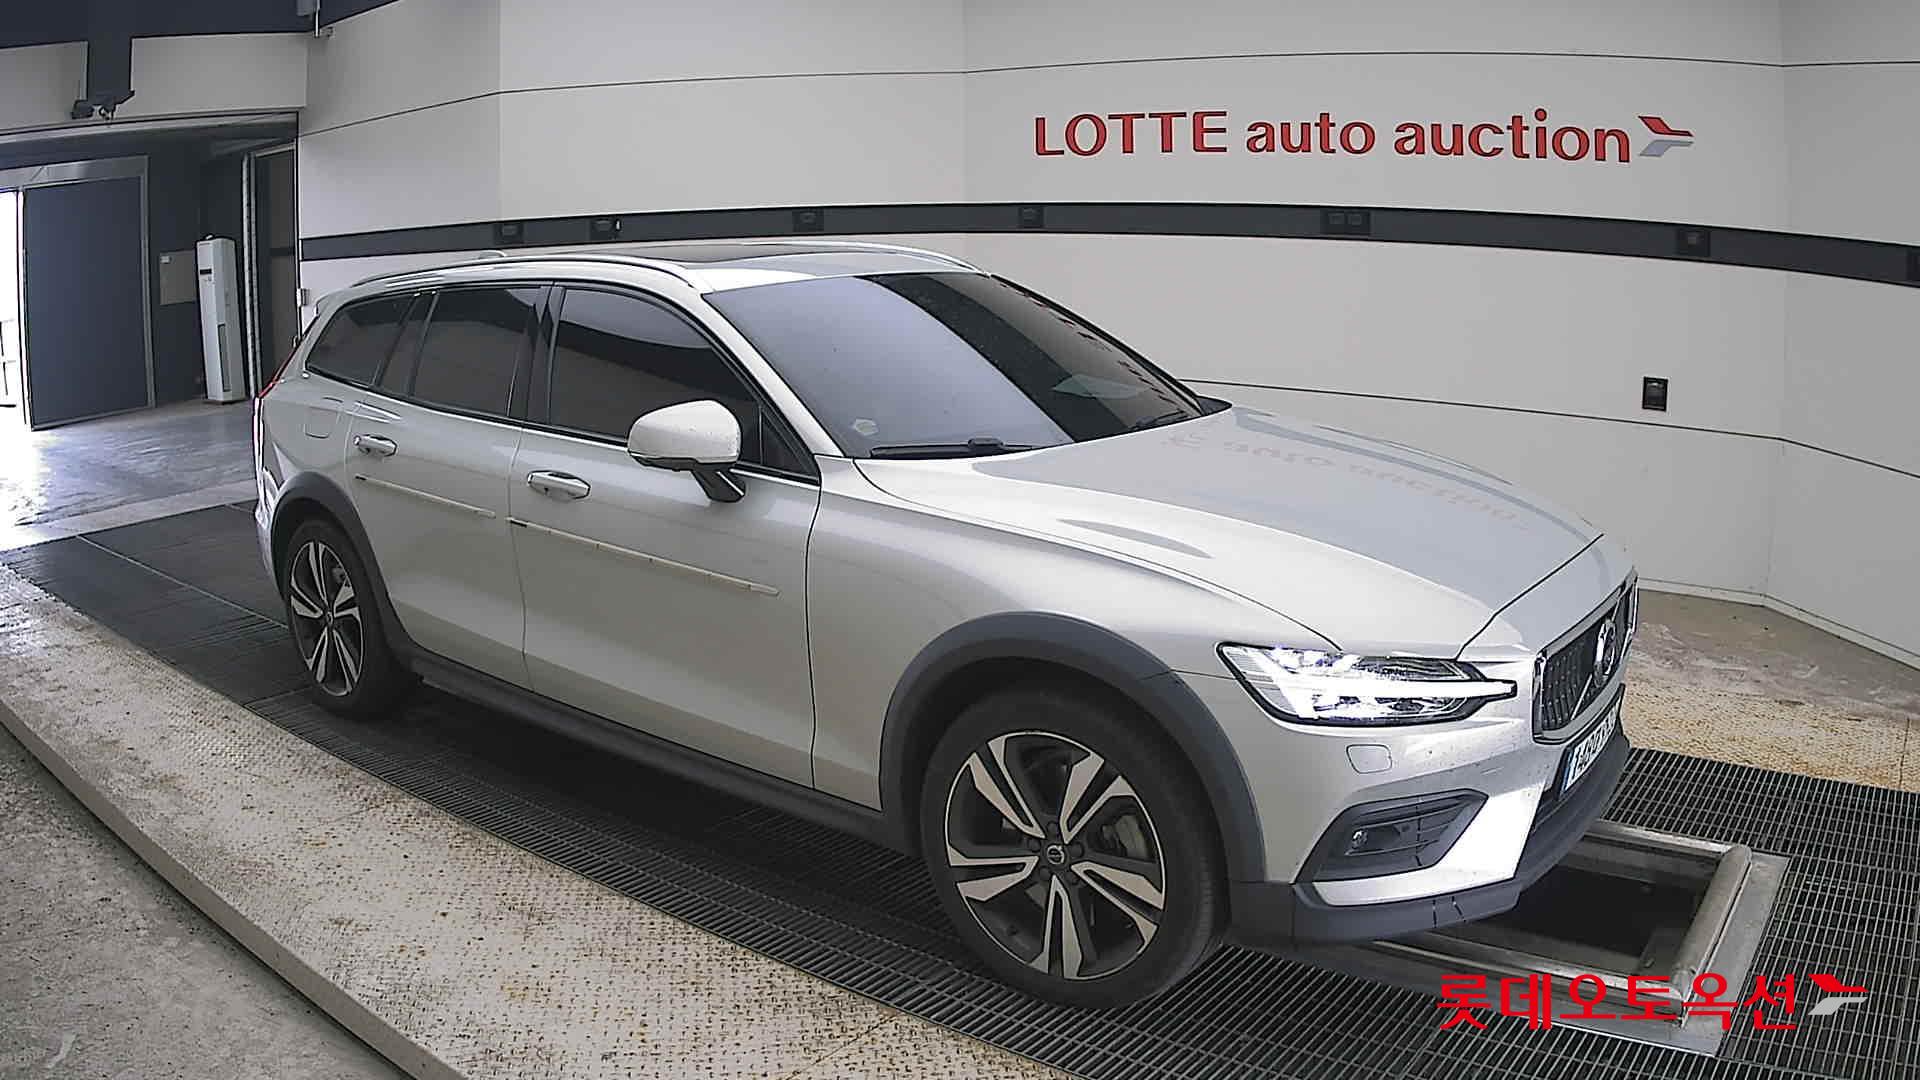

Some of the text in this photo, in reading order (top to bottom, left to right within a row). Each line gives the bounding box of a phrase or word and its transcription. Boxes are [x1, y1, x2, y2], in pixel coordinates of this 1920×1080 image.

[1034, 108, 1631, 163] LOTTE auto auction
